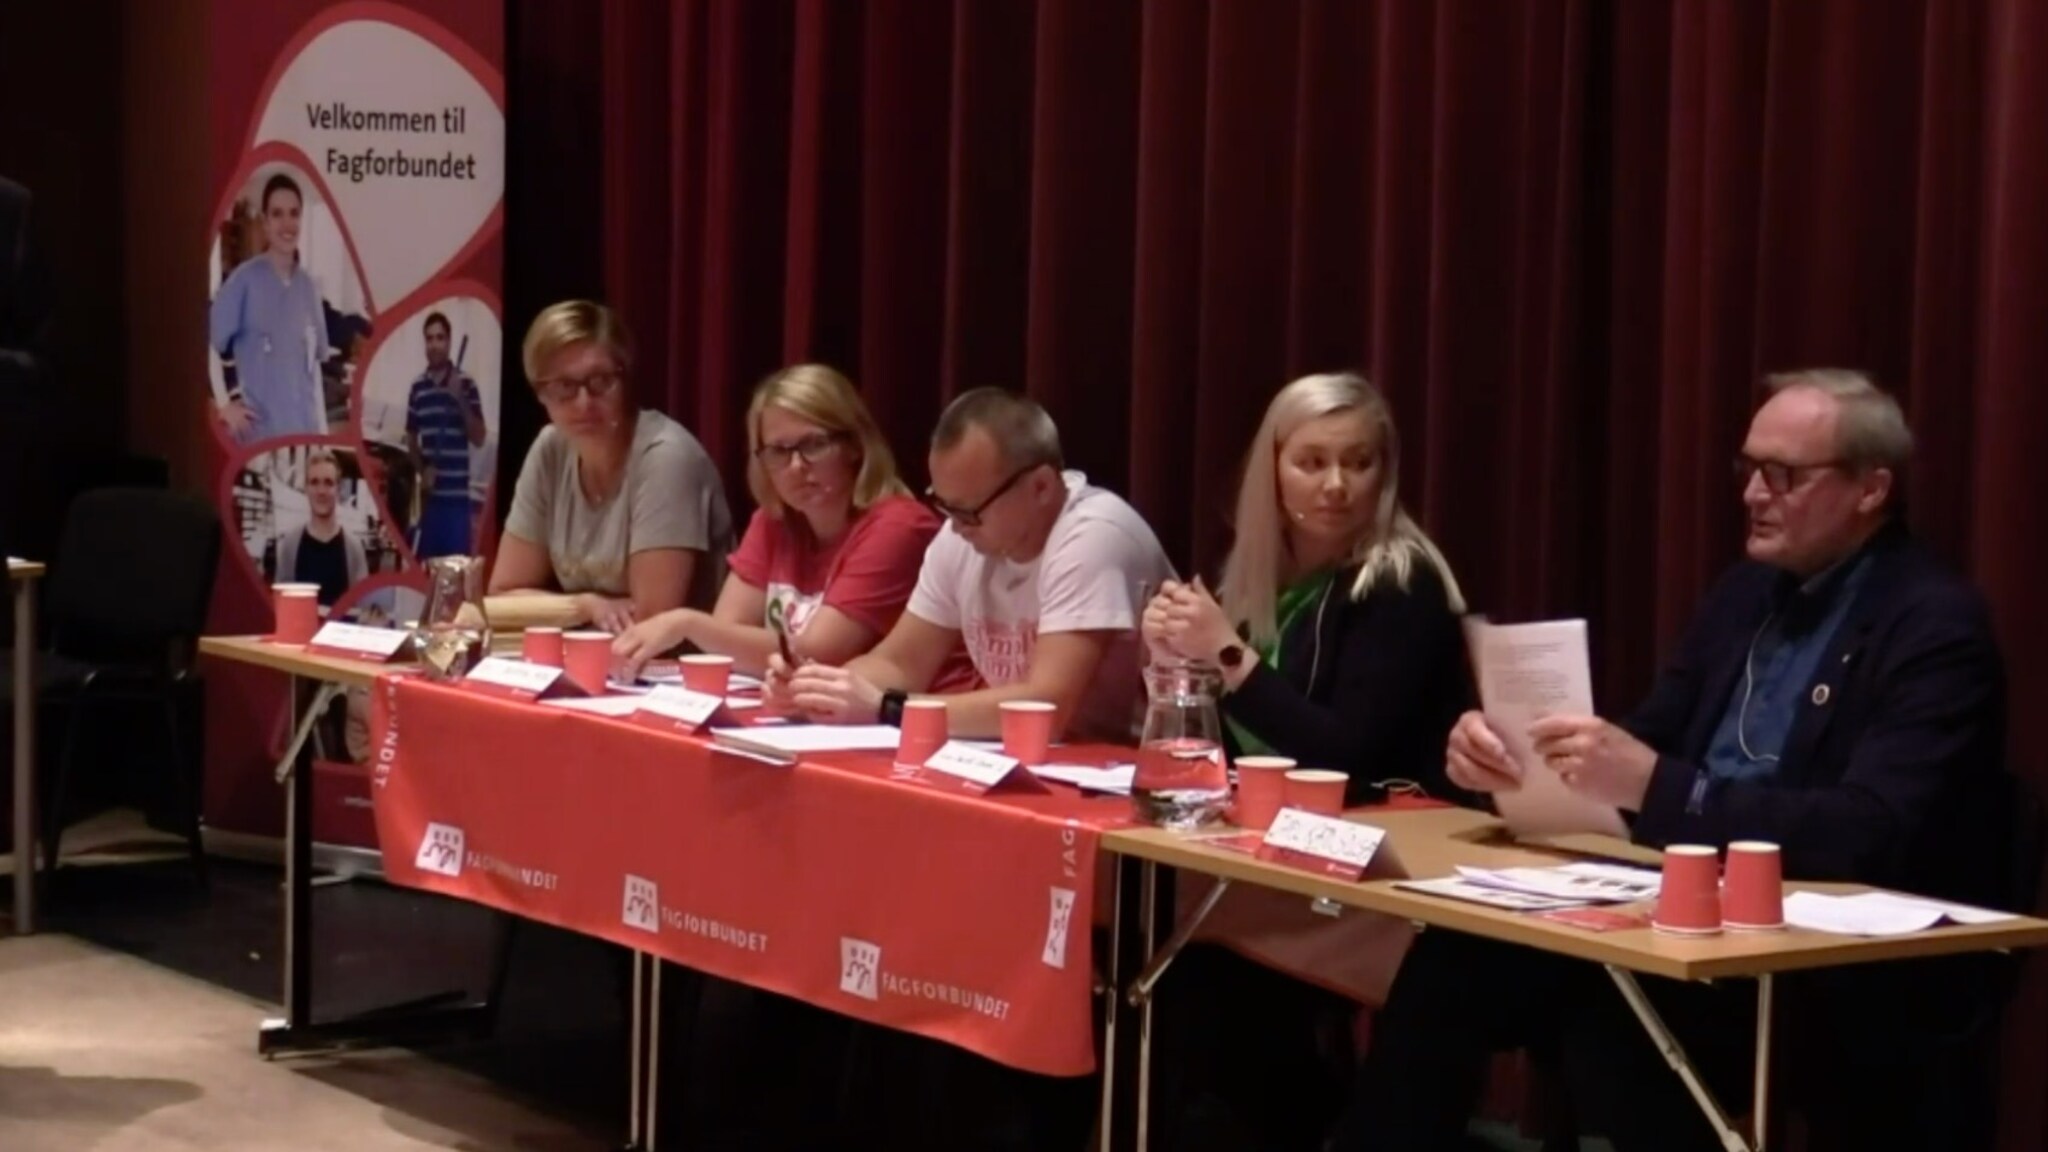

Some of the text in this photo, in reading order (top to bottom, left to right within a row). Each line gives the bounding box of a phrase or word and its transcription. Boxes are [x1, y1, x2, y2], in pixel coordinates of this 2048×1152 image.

[306, 103, 465, 134] Velkommen til
[326, 148, 477, 183] Fagforbundet
[661, 906, 768, 953] FAGFORBUNDET
[882, 972, 1010, 1021] FAGFORBUNDET
